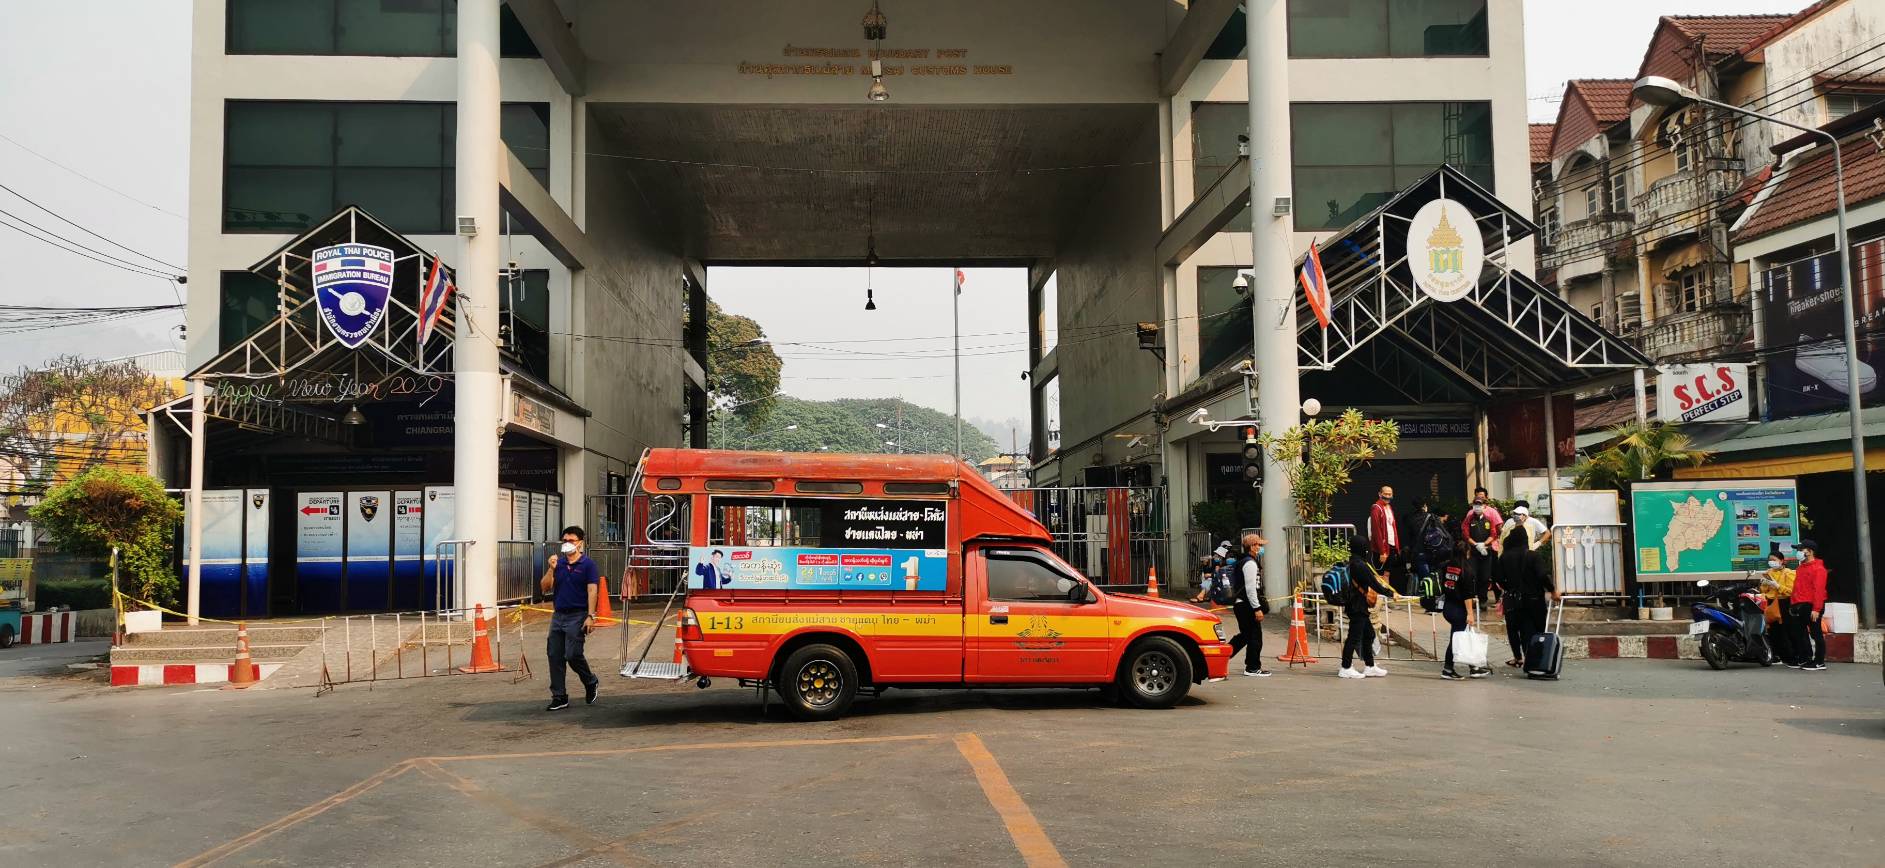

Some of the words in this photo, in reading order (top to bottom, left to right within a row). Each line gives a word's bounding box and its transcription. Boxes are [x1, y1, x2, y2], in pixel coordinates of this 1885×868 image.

[911, 64, 967, 76] CUSTOMS
[973, 64, 1013, 75] HOUSE
[316, 249, 342, 261] ROYAL
[344, 247, 361, 255] THAI
[362, 247, 390, 261] POLICE
[317, 271, 362, 283] IMMIGRATION
[363, 271, 389, 284] BUREAU
[333, 377, 387, 404] Year
[1673, 366, 1735, 411] S.C.S
[1683, 401, 1719, 422] PERFECT
[1720, 391, 1740, 406] STEP
[1400, 423, 1418, 434] AESAI
[1419, 423, 1448, 434] CUSTOMS
[1450, 423, 1471, 433] HOUSE
[708, 616, 744, 630] 1-13
[881, 614, 900, 625] ไทย
[915, 614, 936, 625] พม่า
